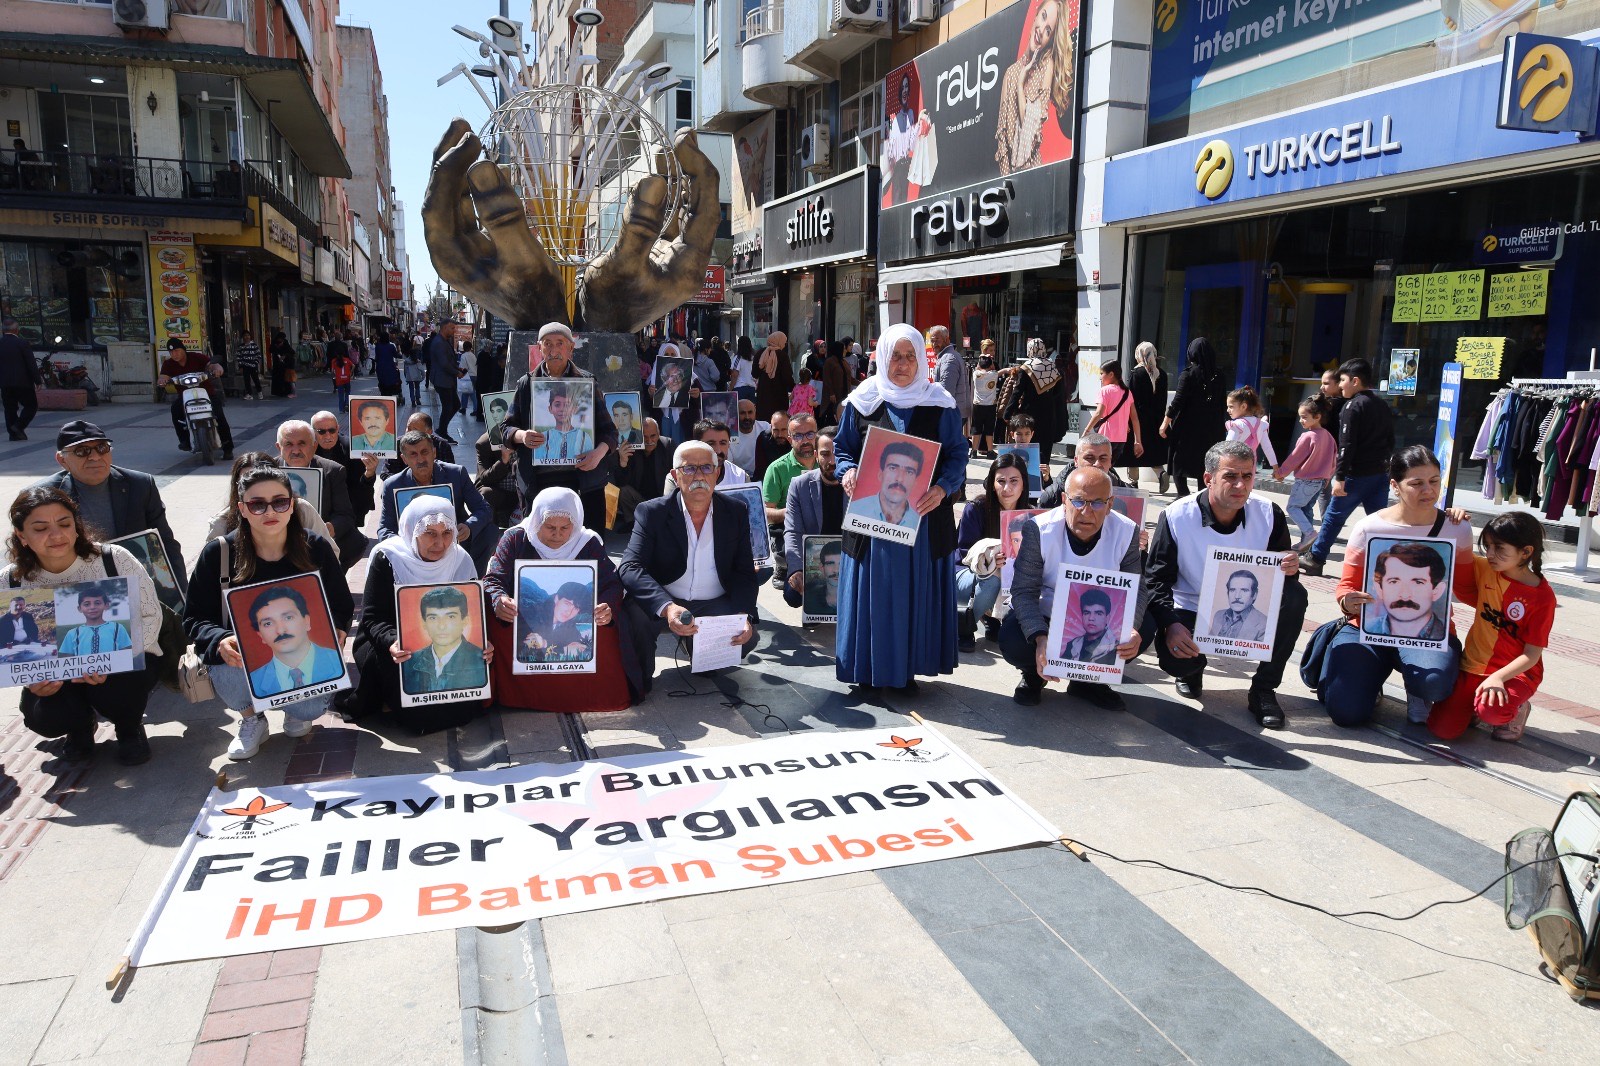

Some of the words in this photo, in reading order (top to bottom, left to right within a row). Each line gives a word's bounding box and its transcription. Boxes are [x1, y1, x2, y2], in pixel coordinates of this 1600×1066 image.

[1193, 5, 1286, 64] internet
[936, 46, 998, 112] rays
[1244, 114, 1401, 180] TURKCELL
[53, 213, 98, 224] ŞEHİR
[786, 196, 832, 244] stilife
[910, 187, 1000, 242] rays
[1520, 226, 1561, 239] Gülistan
[1564, 222, 1586, 234] Cad.
[1406, 277, 1420, 289] GB
[1438, 275, 1448, 286] GB
[1458, 274, 1467, 285] 18
[1469, 273, 1480, 284] GB
[851, 518, 870, 530] Eset
[872, 524, 910, 540] GÖKTAYI
[1214, 550, 1253, 564] İBRAHİM
[1255, 556, 1282, 566] ÇELİK
[1065, 570, 1093, 584] EDİP
[1096, 572, 1132, 588] ÇELİK
[1365, 636, 1396, 645] Medeni
[1399, 638, 1442, 649] GÖKTEPE
[1215, 648, 1248, 657] KAYBEDİLDİ
[10, 658, 60, 674] İBRAHİM
[63, 654, 111, 667] ATILGAN
[1048, 660, 1086, 670] 10/07/1993'DE
[1087, 665, 1121, 674] GÖZALTINDA
[11, 672, 59, 685] VEYSEL
[62, 664, 112, 678] ATILGAN
[1067, 672, 1100, 681] KAYBEDİLDİ
[304, 684, 338, 697] SEVEN
[411, 692, 448, 704] M.ŞİRİN
[450, 690, 482, 699] MALTU
[311, 779, 581, 822] Kayıplar
[601, 750, 877, 794] Bulunsun
[186, 836, 504, 889] Failler
[528, 778, 1006, 850] Yargılansın
[226, 893, 383, 940] İHD
[417, 859, 717, 917] Batman
[737, 818, 975, 879] Şubesi
